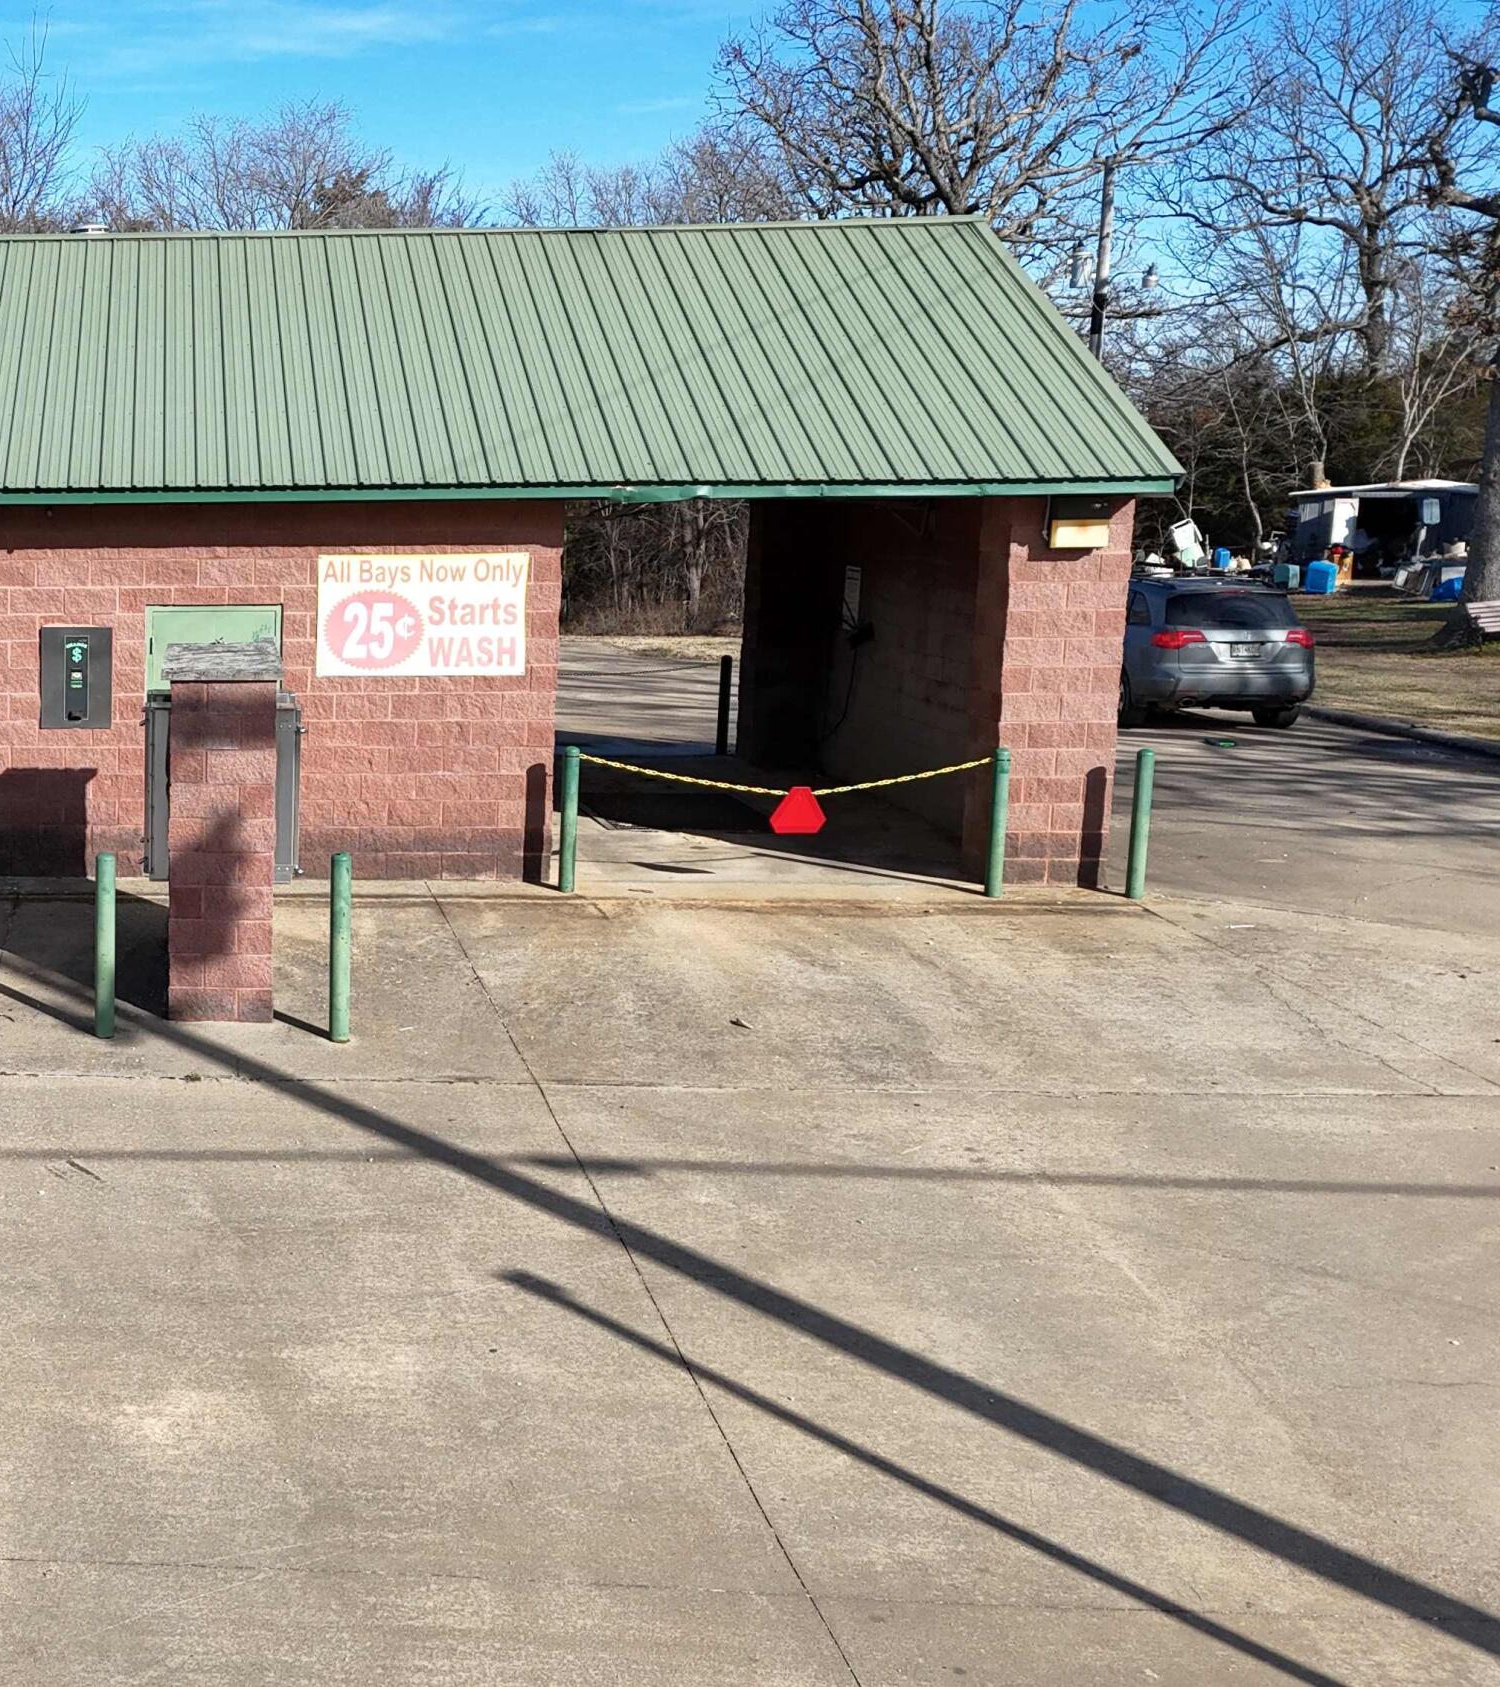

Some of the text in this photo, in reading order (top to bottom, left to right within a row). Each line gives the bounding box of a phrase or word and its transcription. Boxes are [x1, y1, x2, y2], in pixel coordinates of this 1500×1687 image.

[323, 558, 524, 588] All Bays Now Only
[428, 595, 518, 625] Starts
[342, 602, 416, 660] 25¢
[428, 636, 516, 667] WASH
